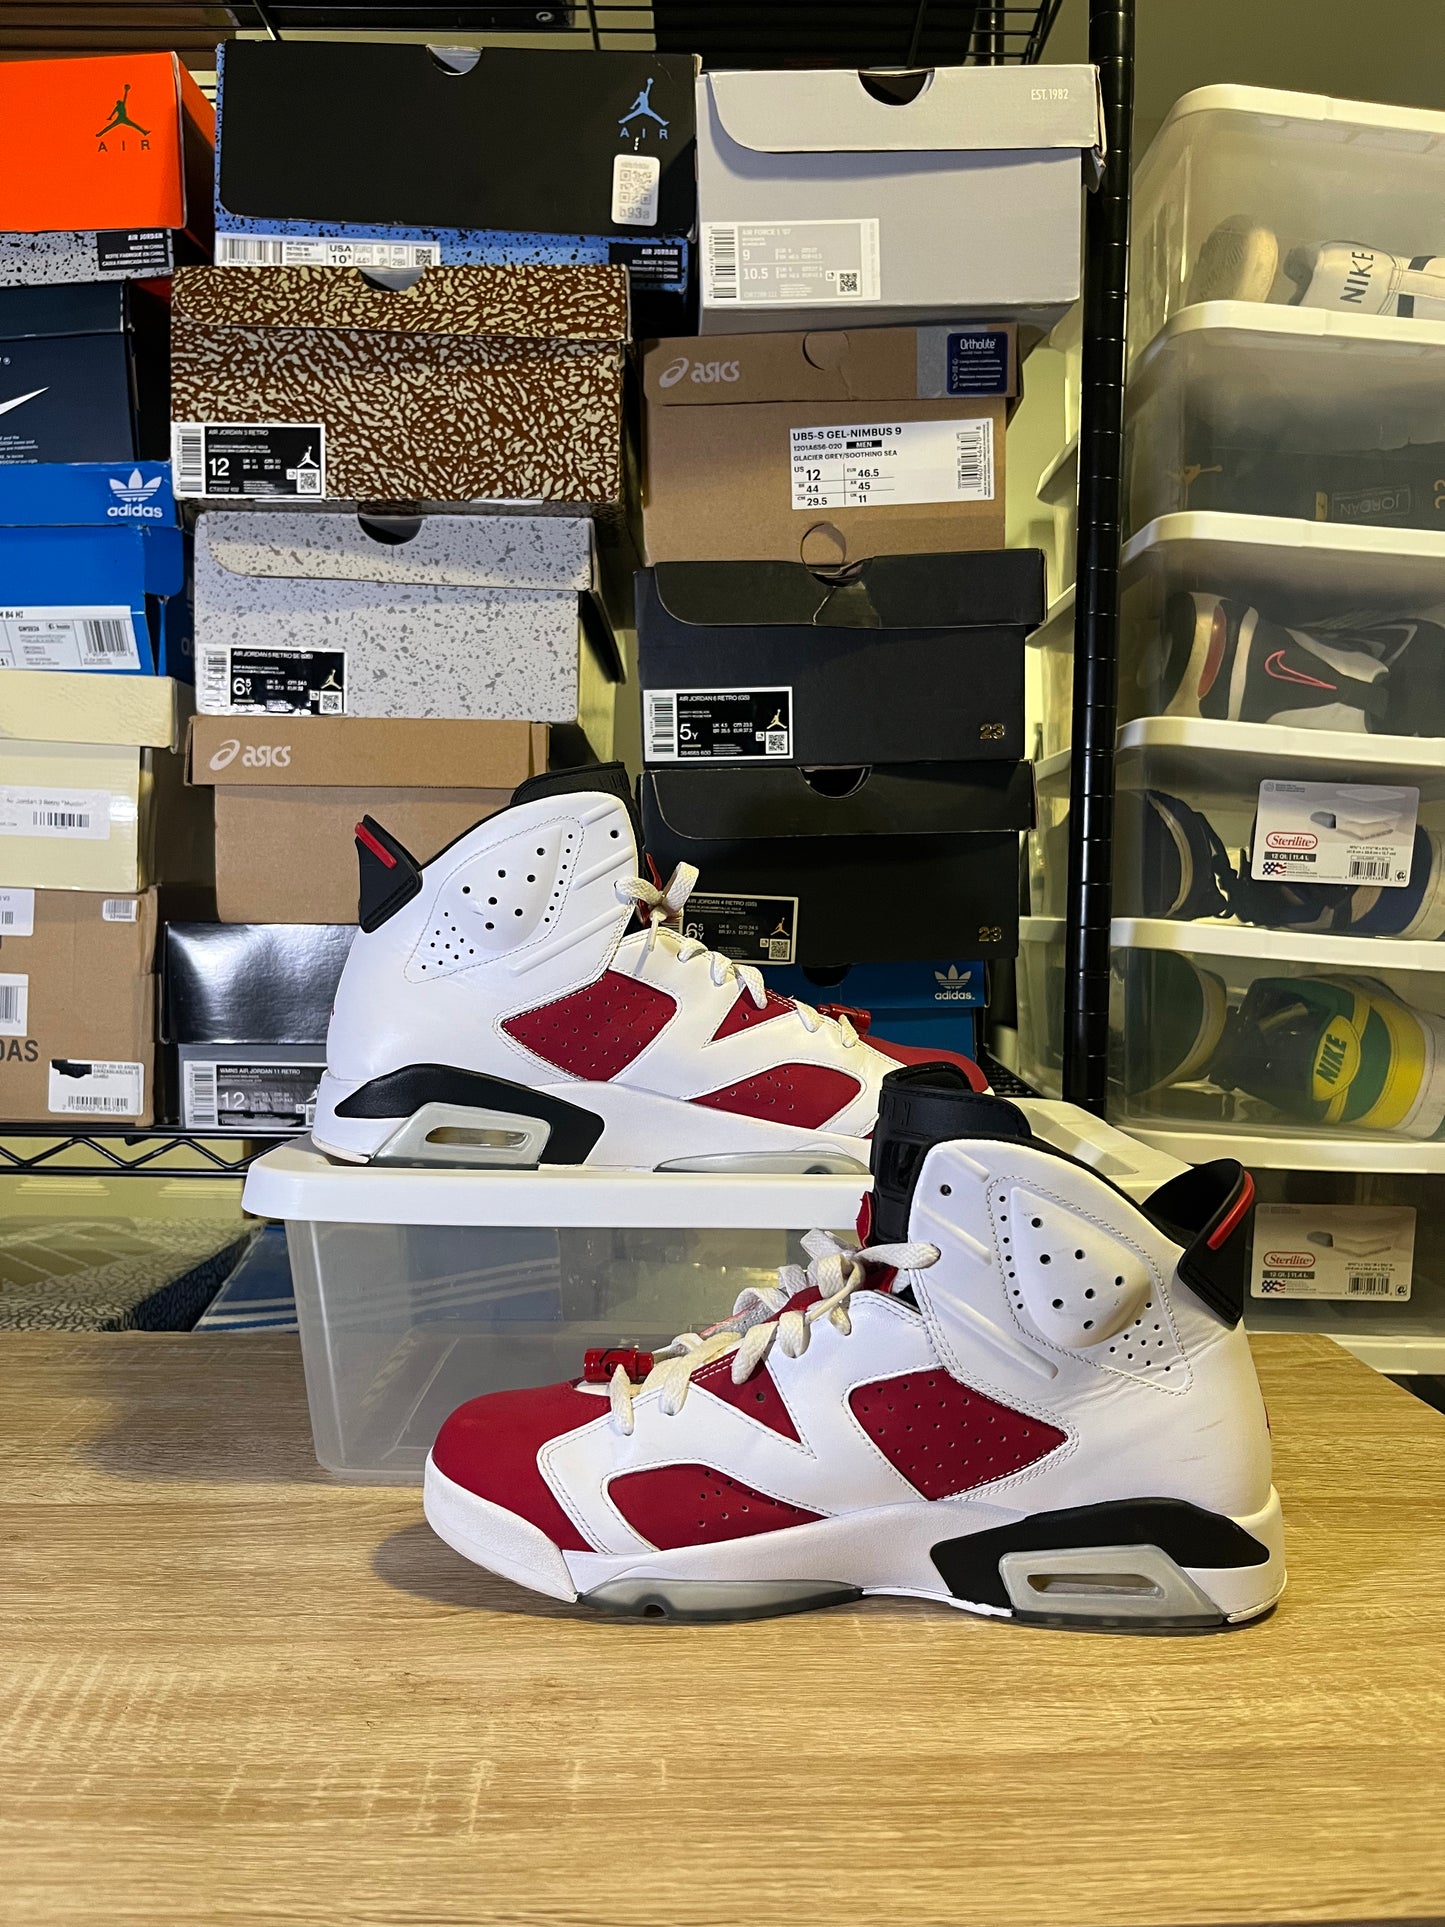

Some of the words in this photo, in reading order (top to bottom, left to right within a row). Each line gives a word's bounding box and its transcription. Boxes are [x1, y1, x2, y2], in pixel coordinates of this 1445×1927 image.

[620, 127, 668, 140] AIR
[97, 140, 150, 152] AIR
[619, 206, 650, 219] b93a
[742, 249, 750, 260] 9
[743, 268, 768, 279] 10.5
[1339, 251, 1374, 304] NIKE
[691, 361, 739, 383] asics
[793, 432, 824, 441] UB5-S
[826, 428, 893, 439] GEL-NIMBUS
[895, 427, 902, 435] 9
[825, 451, 882, 460] GREY/SOOTHING
[209, 457, 230, 476] 12
[806, 469, 821, 481] 12
[858, 469, 879, 477] 46.5
[806, 485, 819, 493] 44
[858, 482, 870, 490] 45
[807, 497, 827, 506] 29.5
[859, 495, 867, 503] 11
[1340, 494, 1400, 515] JORDAN
[107, 504, 163, 518] adidas
[980, 723, 1004, 739] 23
[242, 745, 291, 767] asics
[1272, 835, 1311, 847] Sterilite
[979, 927, 1001, 941] 23
[935, 991, 972, 1000] adidas
[1315, 1033, 1347, 1085] NIKE
[221, 1091, 245, 1110] 12
[1269, 1254, 1309, 1265] Sterilite
